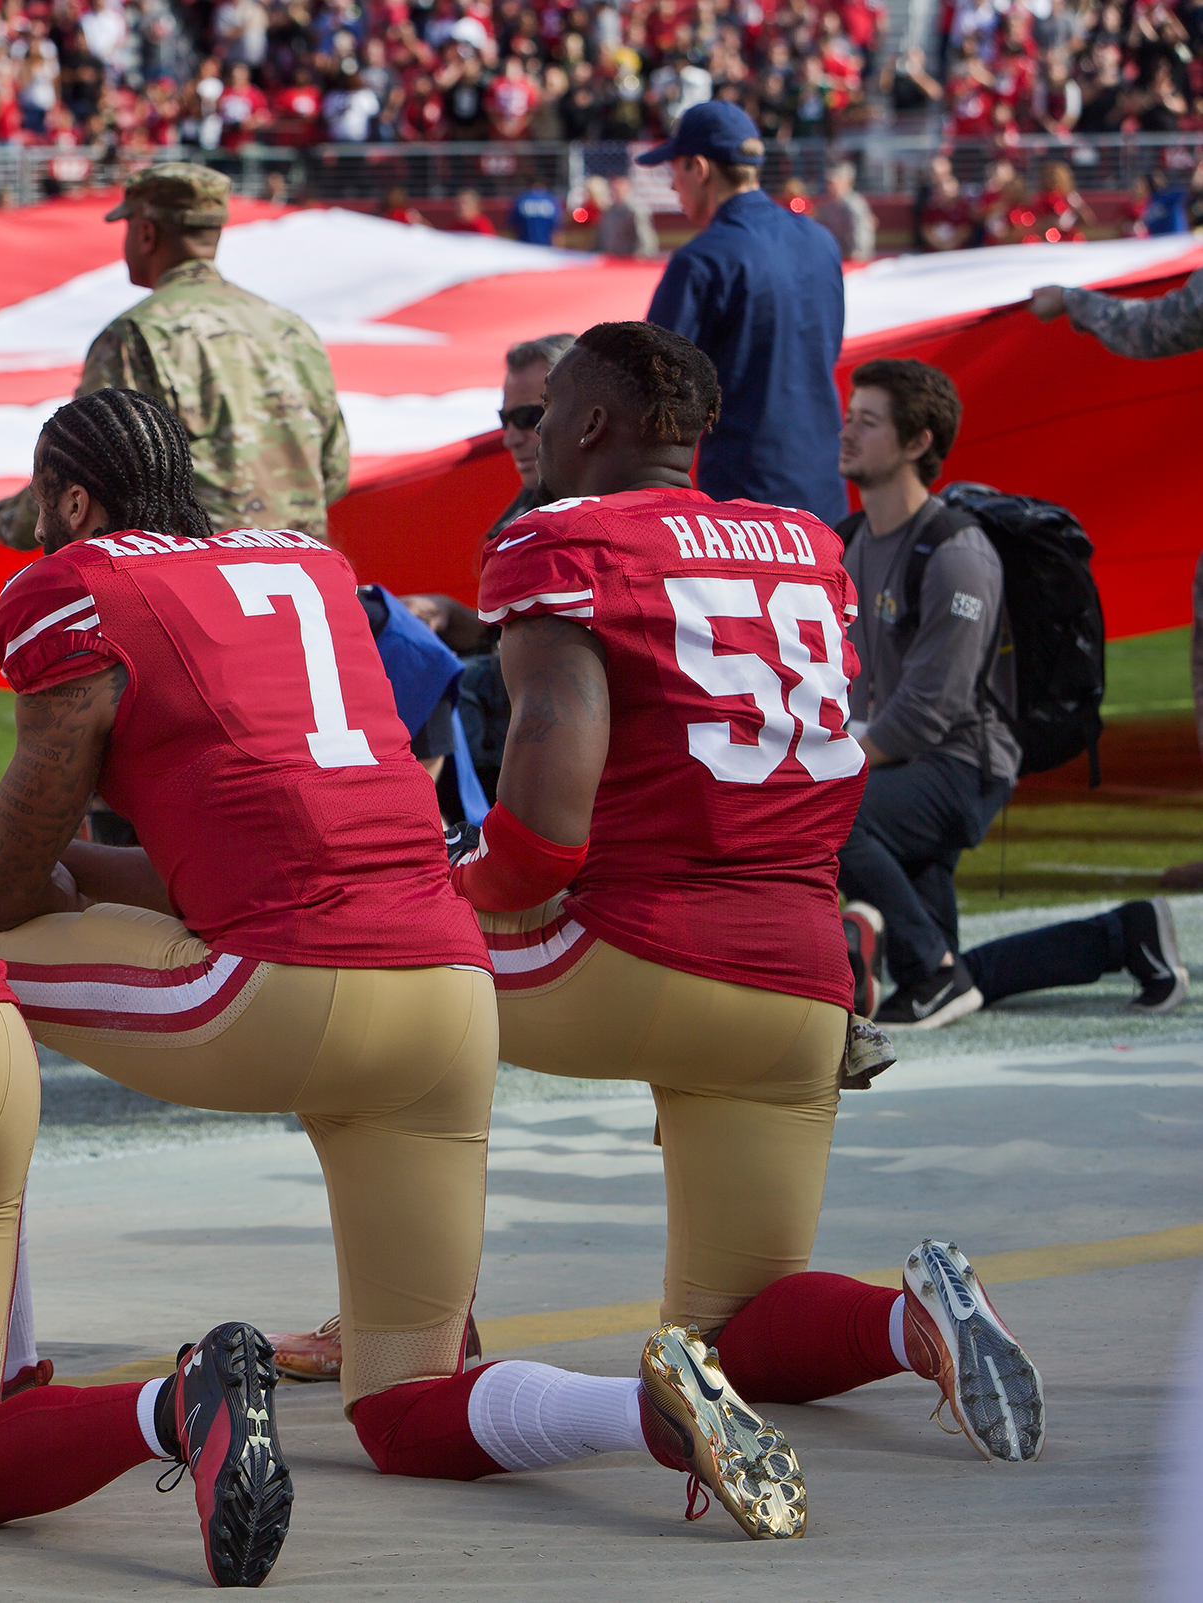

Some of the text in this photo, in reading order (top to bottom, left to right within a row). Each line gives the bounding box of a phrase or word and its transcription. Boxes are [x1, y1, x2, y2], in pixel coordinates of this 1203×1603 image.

[661, 515, 817, 566] HAROLD
[217, 562, 380, 769] 7
[663, 577, 867, 784] 58
